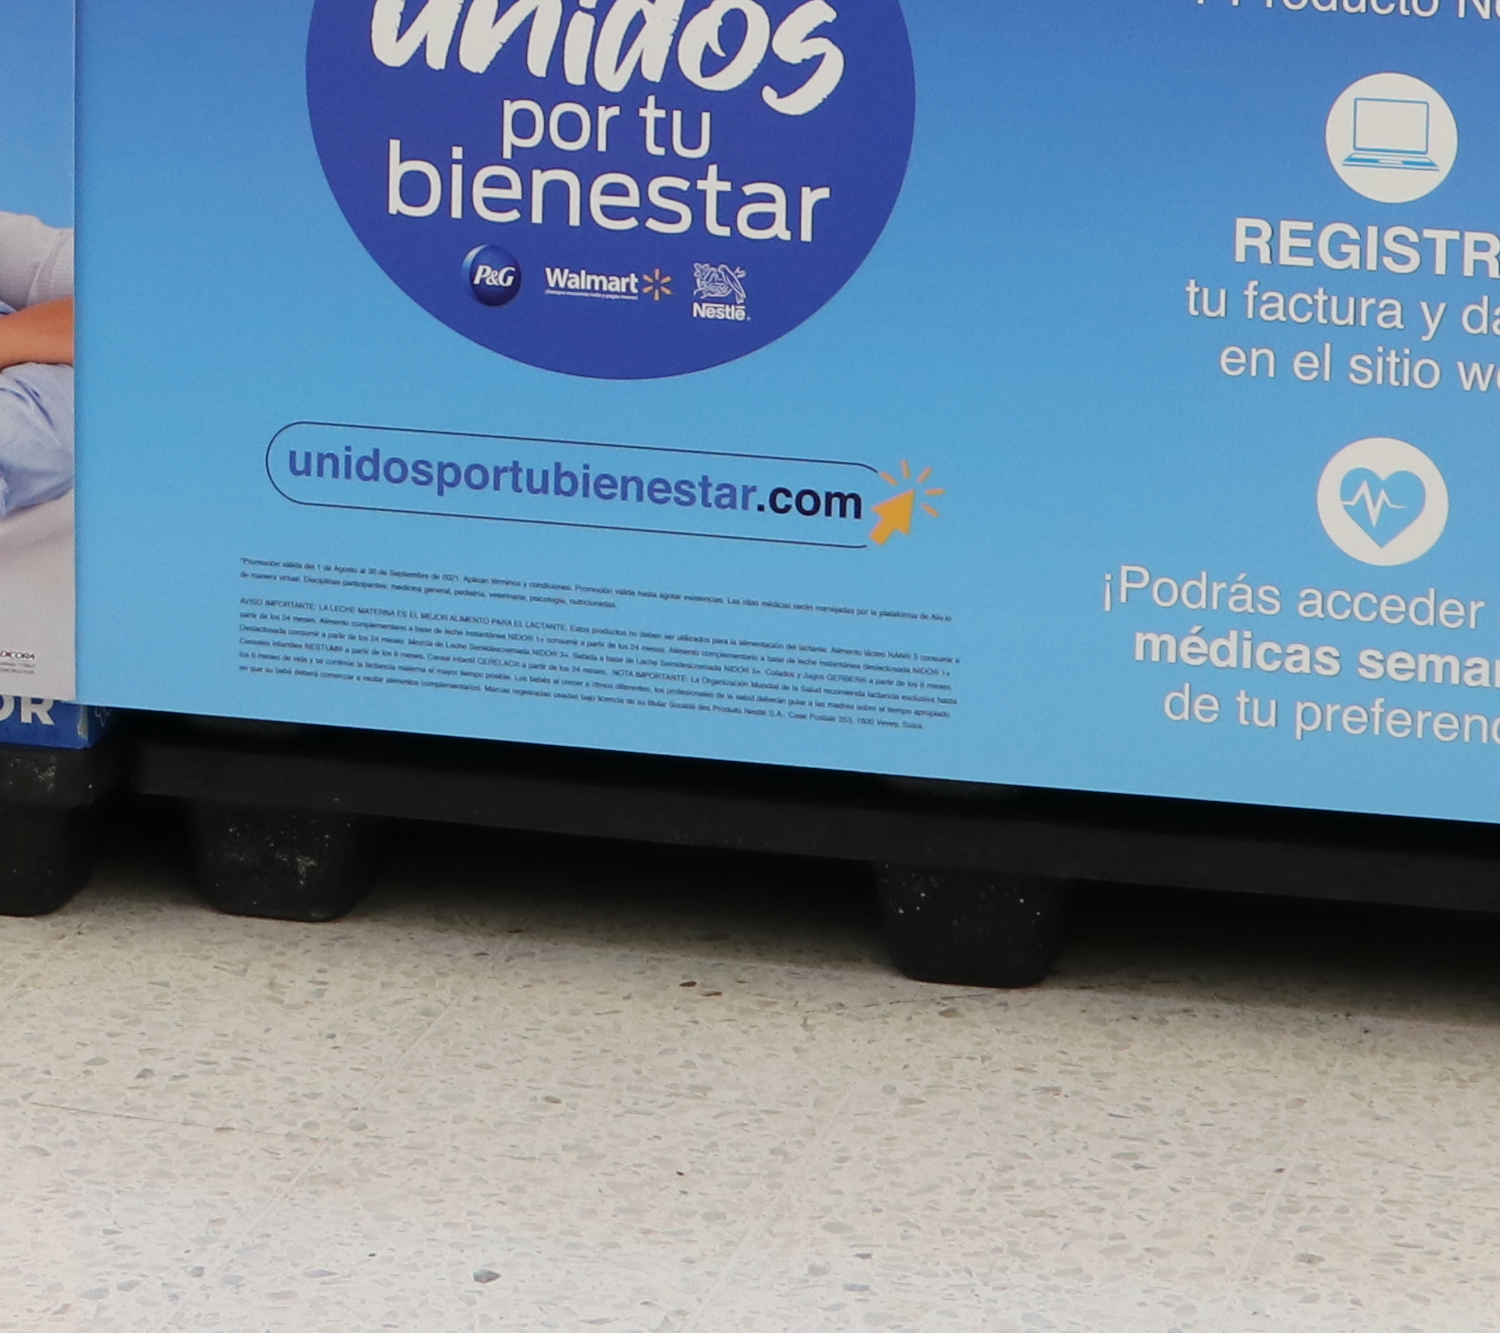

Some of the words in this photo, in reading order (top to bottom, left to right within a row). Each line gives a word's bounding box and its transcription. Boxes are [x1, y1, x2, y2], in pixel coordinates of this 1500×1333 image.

[502, 95, 620, 158] por
[640, 99, 712, 158] tu
[387, 139, 832, 243] bienestar
[474, 264, 516, 289] P&G
[546, 267, 639, 296] Walmart
[692, 301, 745, 321] Nestlé
[1186, 281, 1228, 318] tu
[1241, 279, 1405, 331] factura
[1419, 298, 1447, 342] y
[1218, 346, 1278, 379] en
[1291, 343, 1333, 382] el
[1347, 348, 1441, 391] sitio
[288, 444, 864, 520] unidosportubienestar.com
[1101, 567, 1282, 617] ¡Podrás
[1296, 579, 1486, 632] acceder
[1133, 625, 1341, 678] médicas
[1162, 684, 1222, 725] de
[1236, 691, 1278, 729] tu
